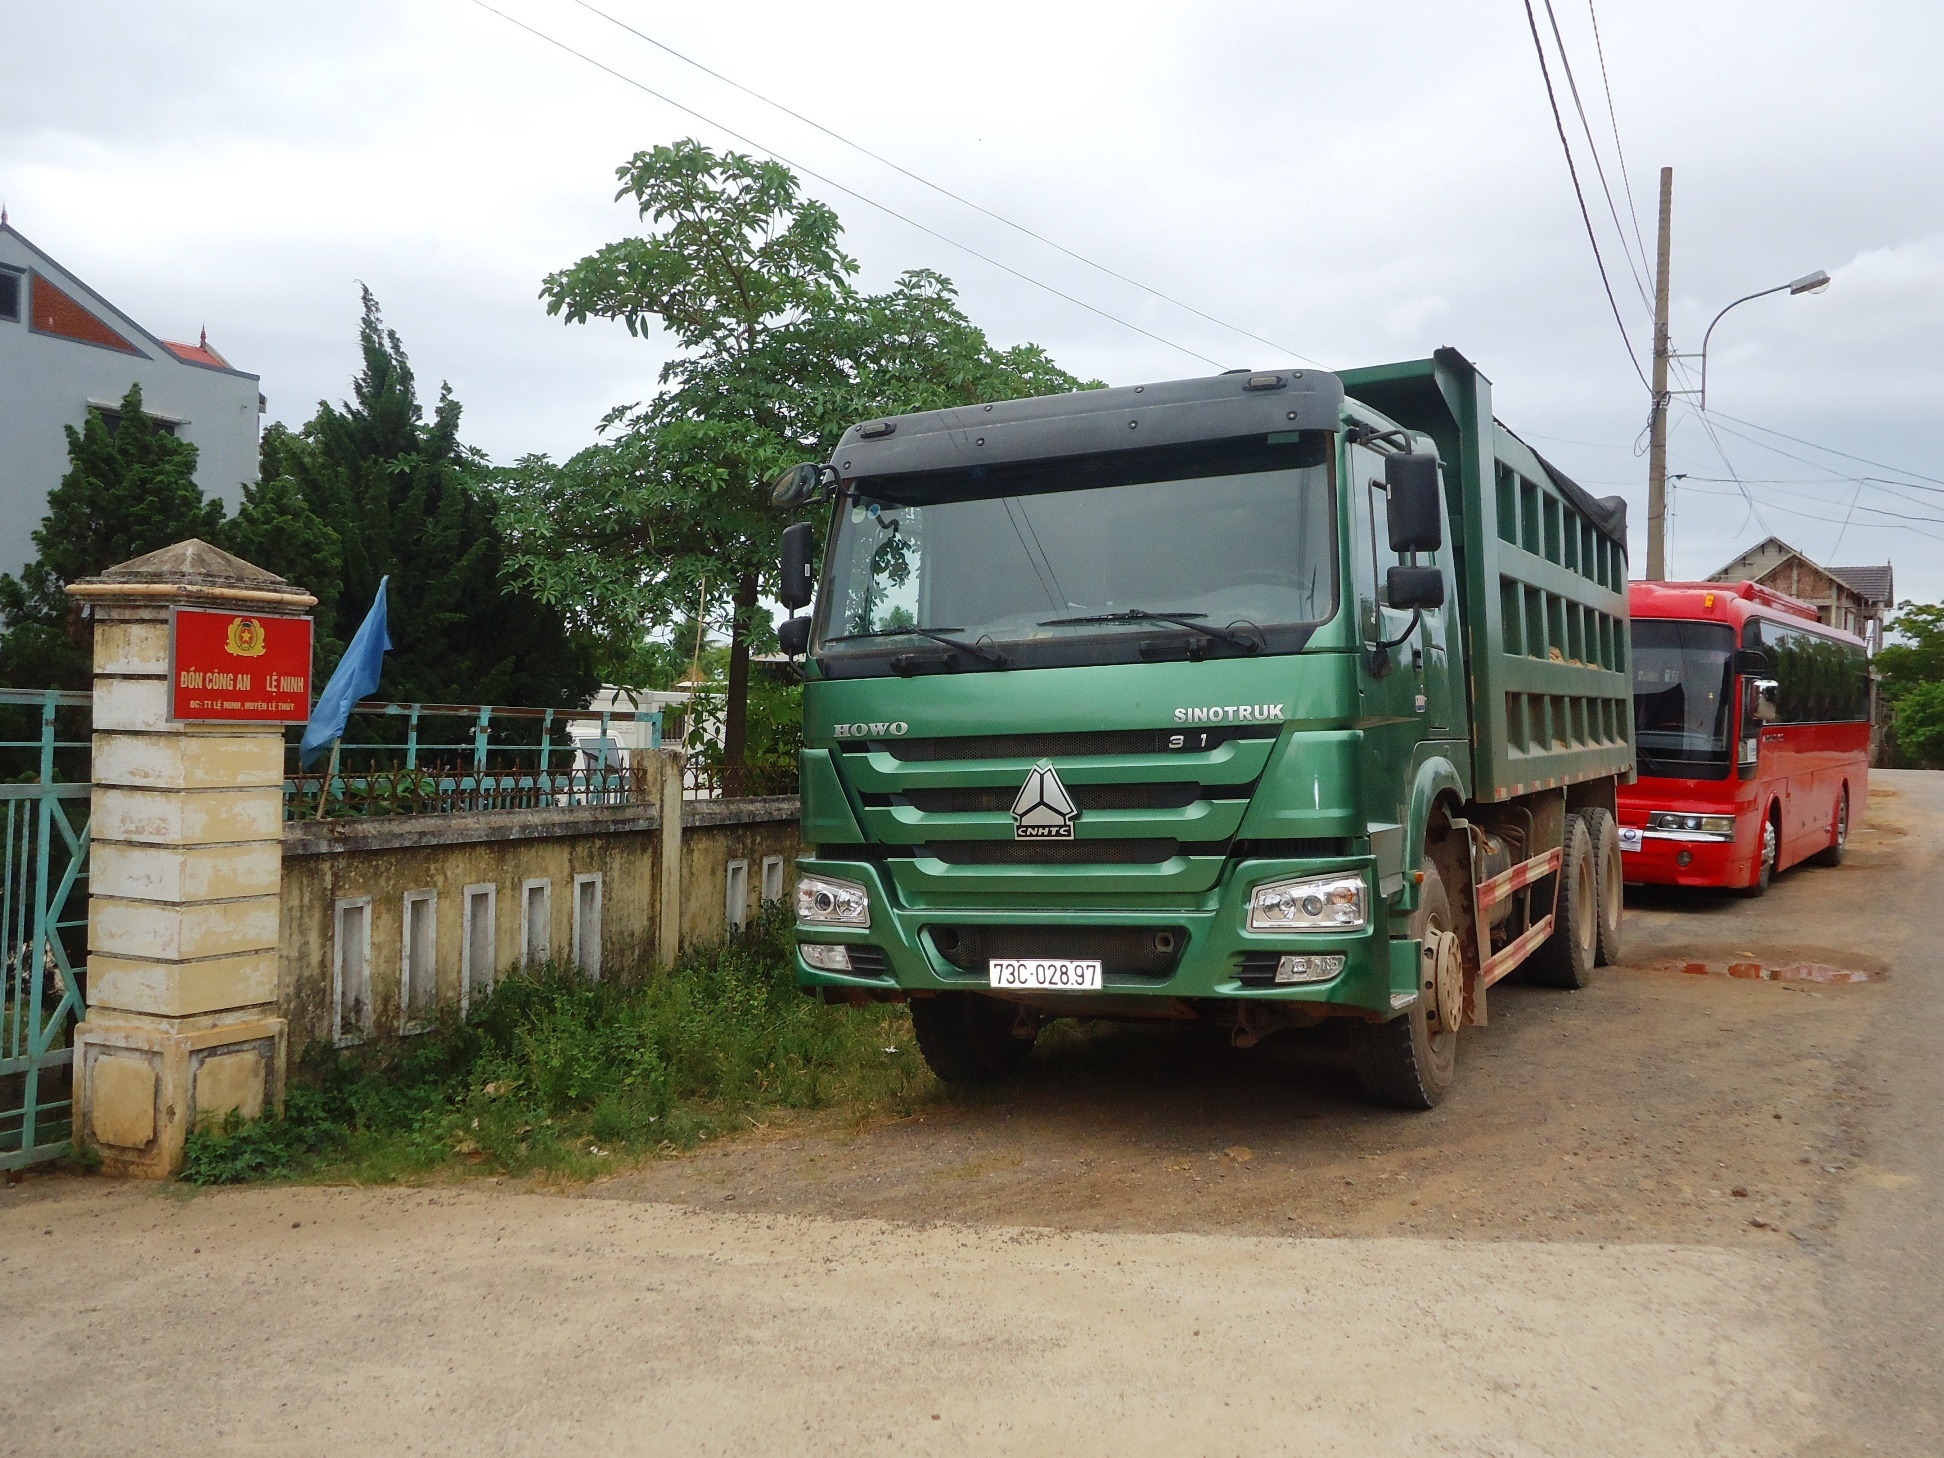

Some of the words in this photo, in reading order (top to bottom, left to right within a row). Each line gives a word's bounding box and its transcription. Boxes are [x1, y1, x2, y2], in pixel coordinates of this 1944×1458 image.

[205, 668, 234, 690] CÔNG
[236, 673, 251, 691] AN
[266, 672, 278, 696] LỆ
[280, 676, 304, 693] NINH
[204, 700, 212, 709] TT
[1173, 704, 1285, 723] SINOTRUK
[833, 721, 909, 738] HOWO
[1168, 735, 1185, 749] 3
[1200, 733, 1207, 747] 1
[1017, 827, 1070, 836] CNHTC
[993, 963, 1097, 986] 73C-028.97
